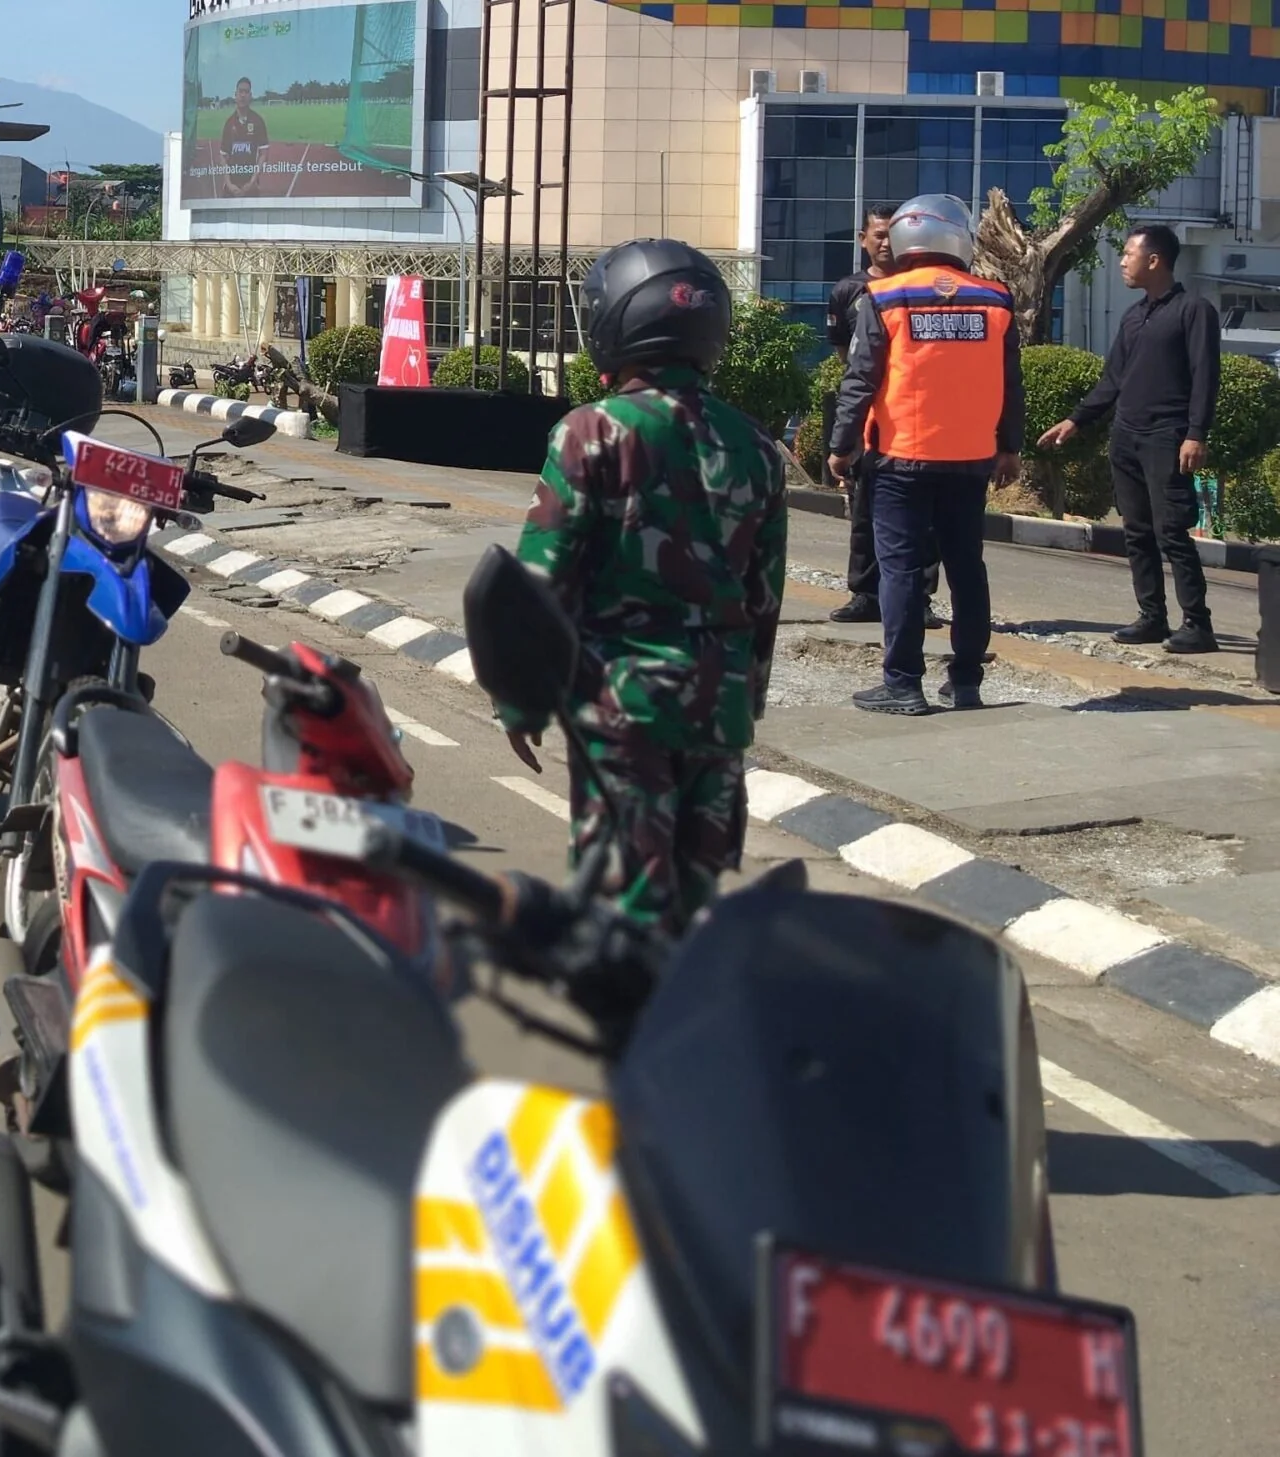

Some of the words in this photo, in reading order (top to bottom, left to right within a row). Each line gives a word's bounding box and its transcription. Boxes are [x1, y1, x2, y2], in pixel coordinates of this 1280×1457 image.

[209, 163, 260, 175] keterbatasan
[262, 161, 303, 173] fasilitas
[307, 160, 363, 172] tersebut
[911, 313, 984, 332] DISHUB
[913, 331, 956, 340] KABUPATEN
[958, 331, 984, 340] BOGOR
[81, 443, 93, 462] F
[105, 451, 148, 479] 4273
[169, 469, 181, 489] H
[269, 790, 287, 814] F
[470, 1129, 595, 1397] DISHUB
[788, 1264, 821, 1338] F
[873, 1285, 1013, 1380] 4699
[1080, 1329, 1125, 1399] H
